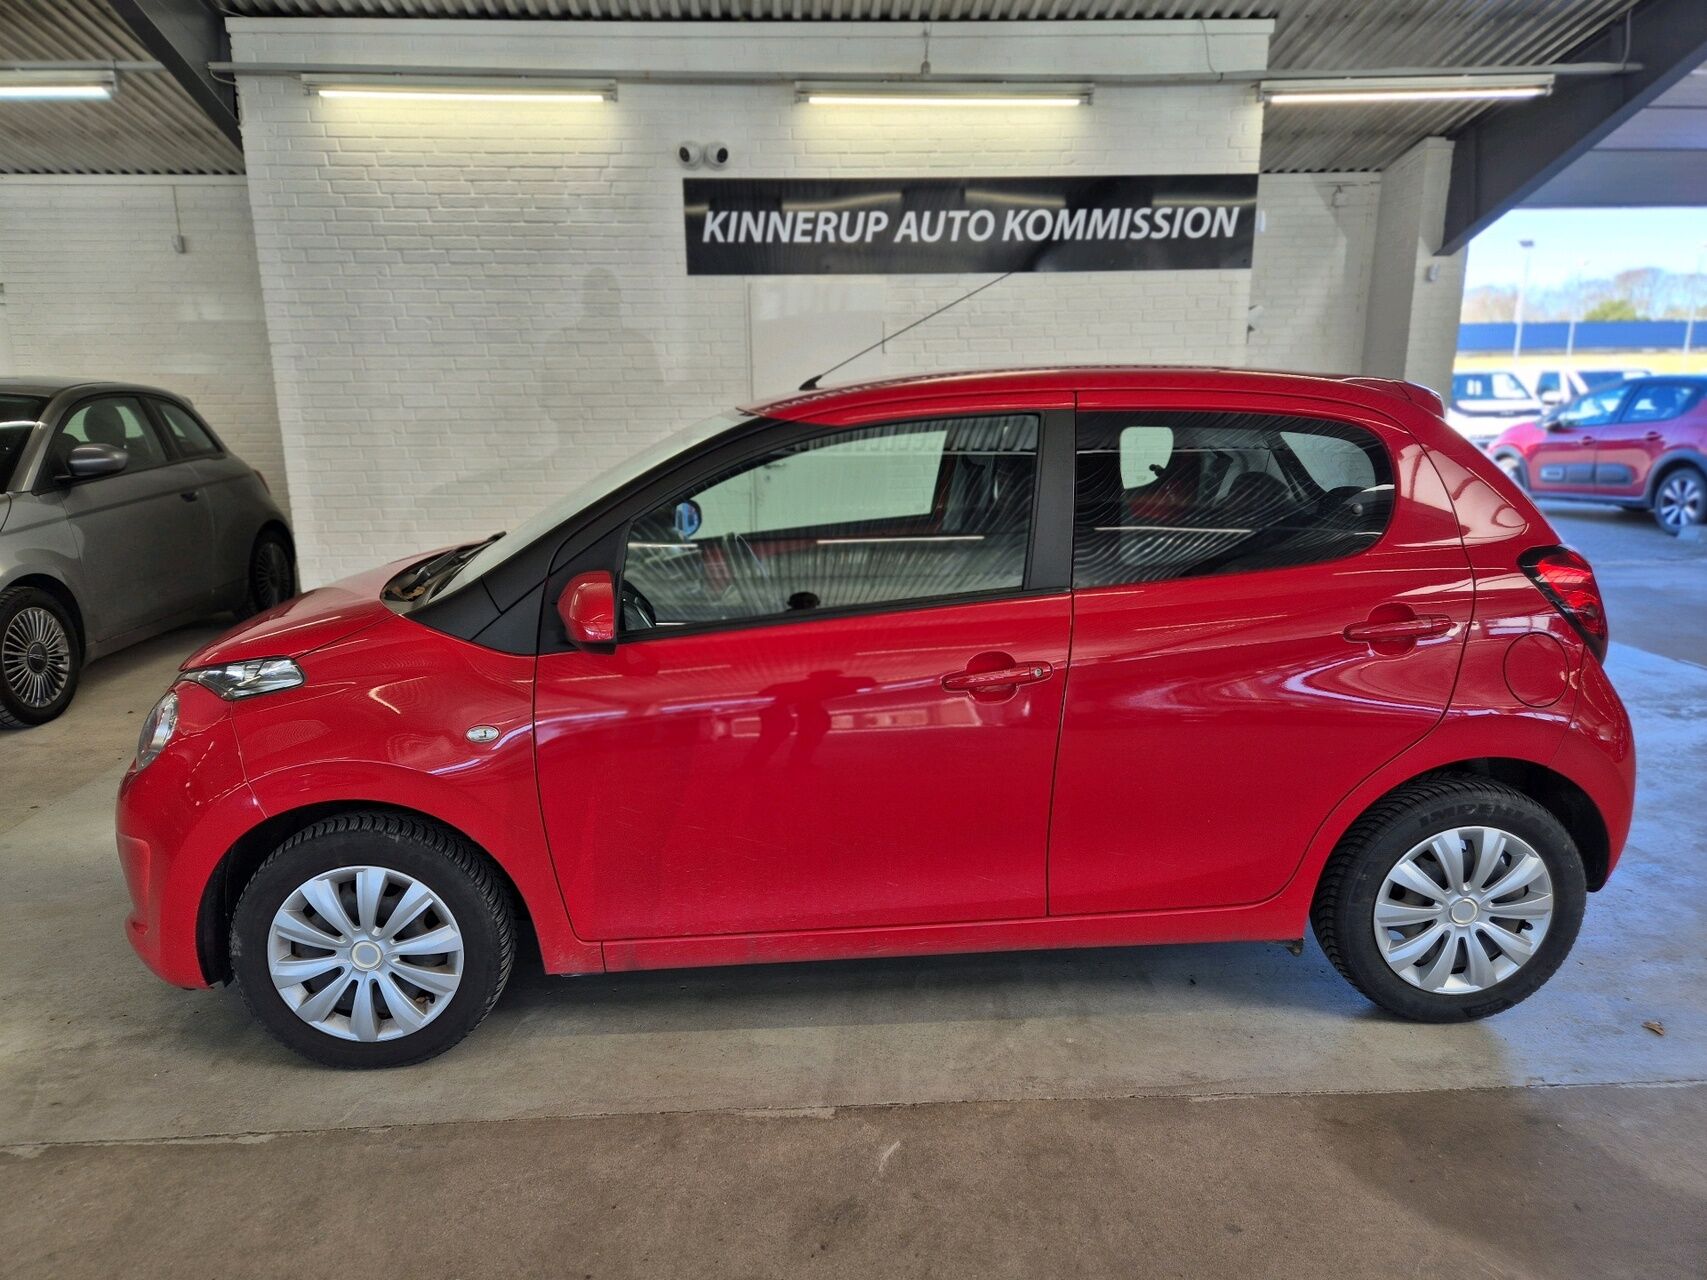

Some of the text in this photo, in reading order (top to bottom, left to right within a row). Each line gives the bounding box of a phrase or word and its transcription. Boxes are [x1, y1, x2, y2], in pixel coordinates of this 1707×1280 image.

[702, 205, 1241, 244] KINNERUP AUTO KOMMISSION
